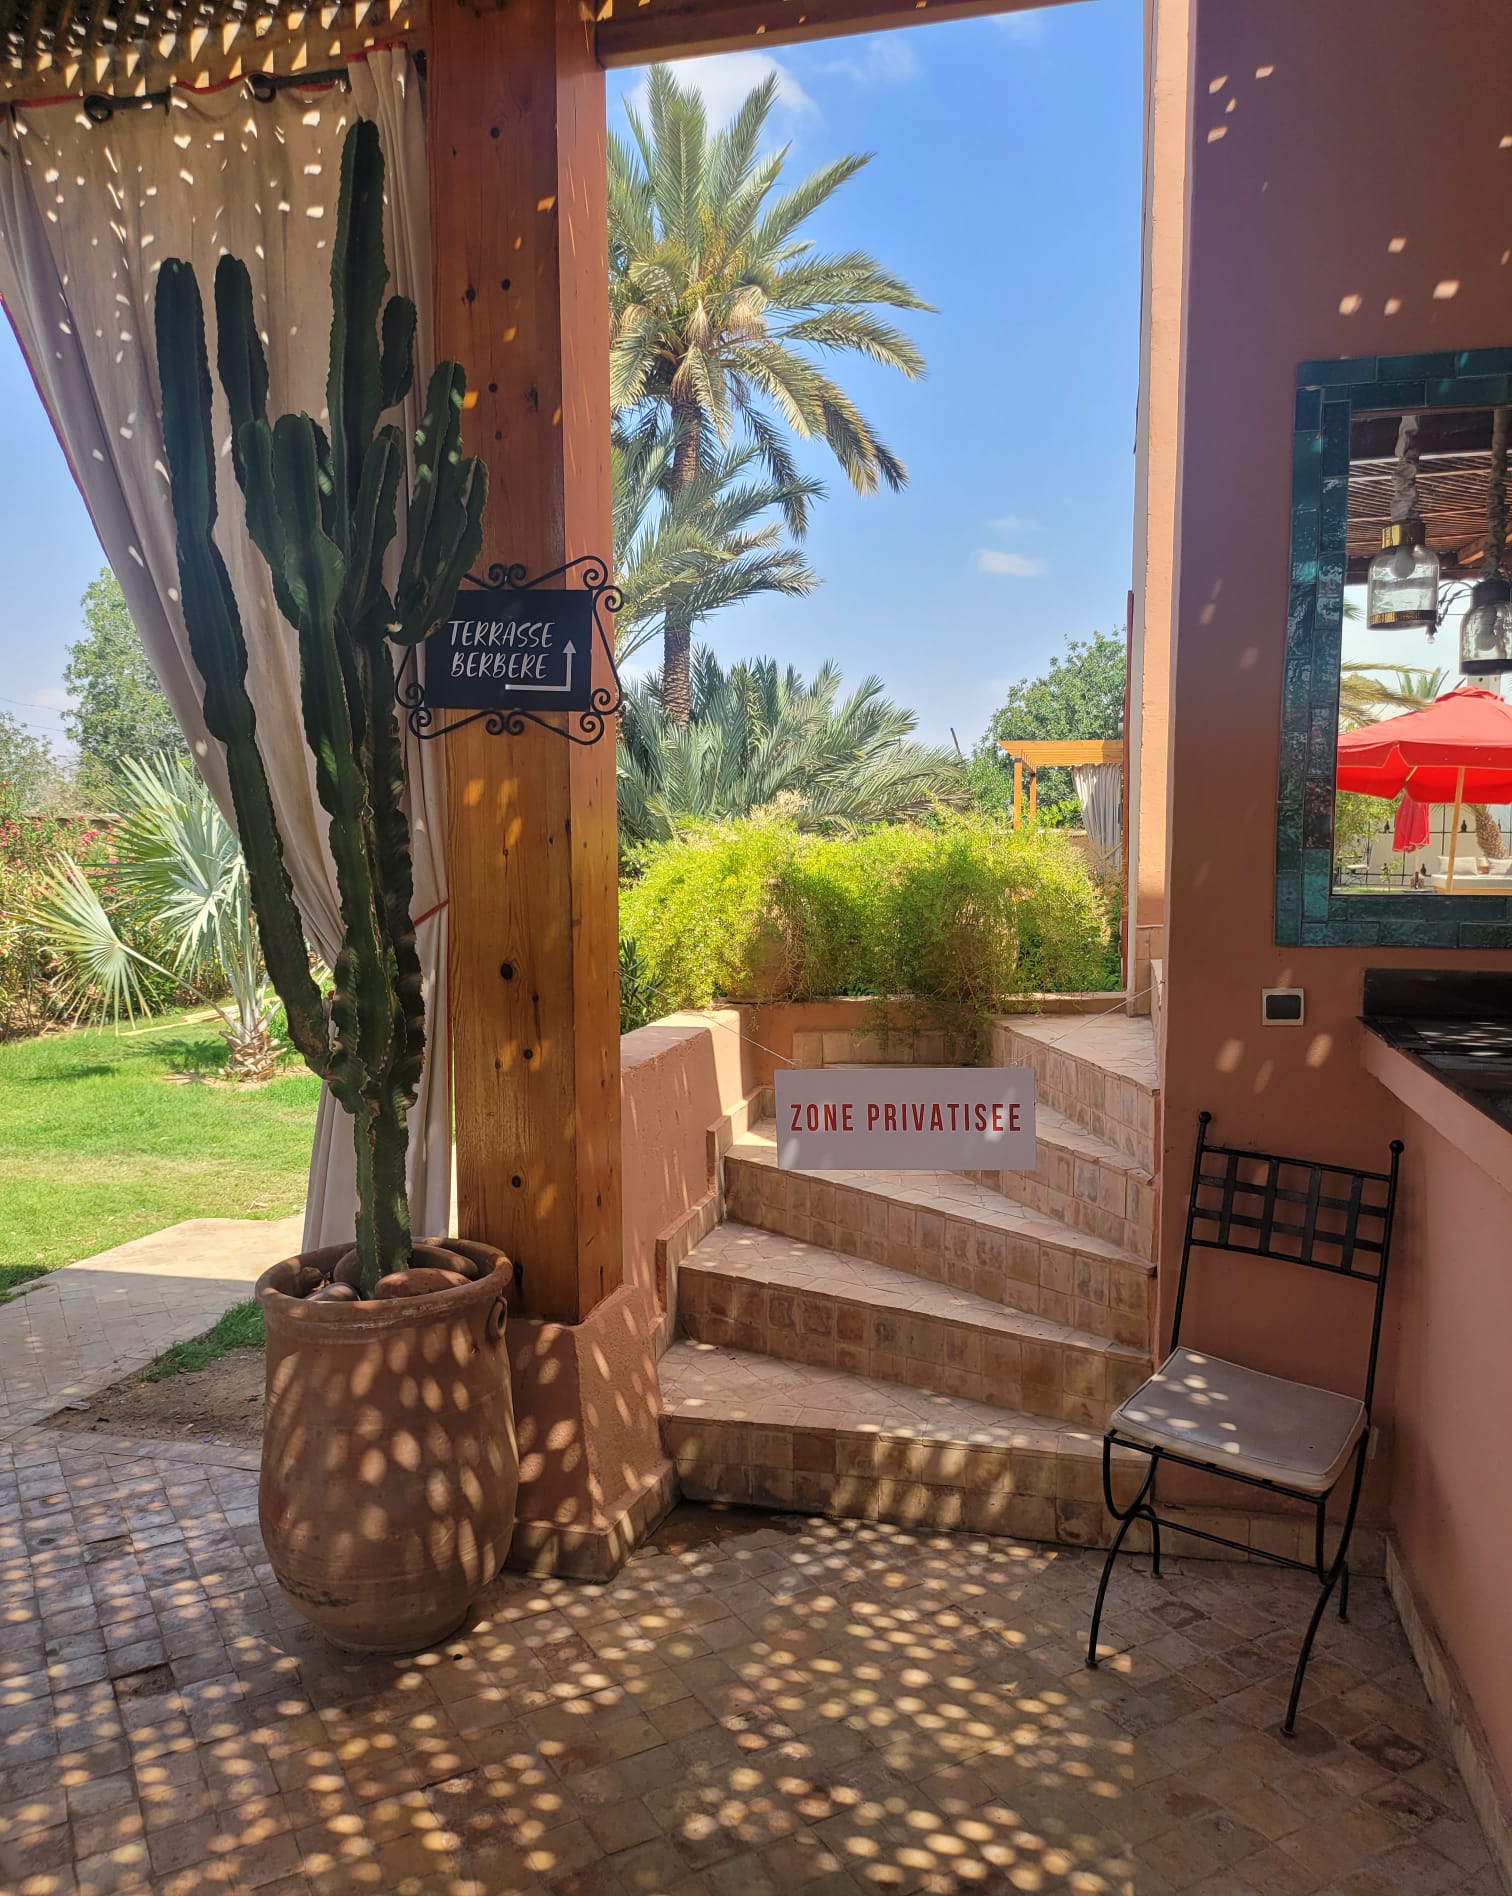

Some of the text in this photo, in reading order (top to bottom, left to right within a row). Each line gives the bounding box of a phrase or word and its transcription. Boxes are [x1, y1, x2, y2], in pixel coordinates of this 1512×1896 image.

[447, 620, 556, 648] TERRASSE
[450, 651, 550, 679] BERBERE
[790, 1103, 1021, 1132] ZONE PRIVATISEE
